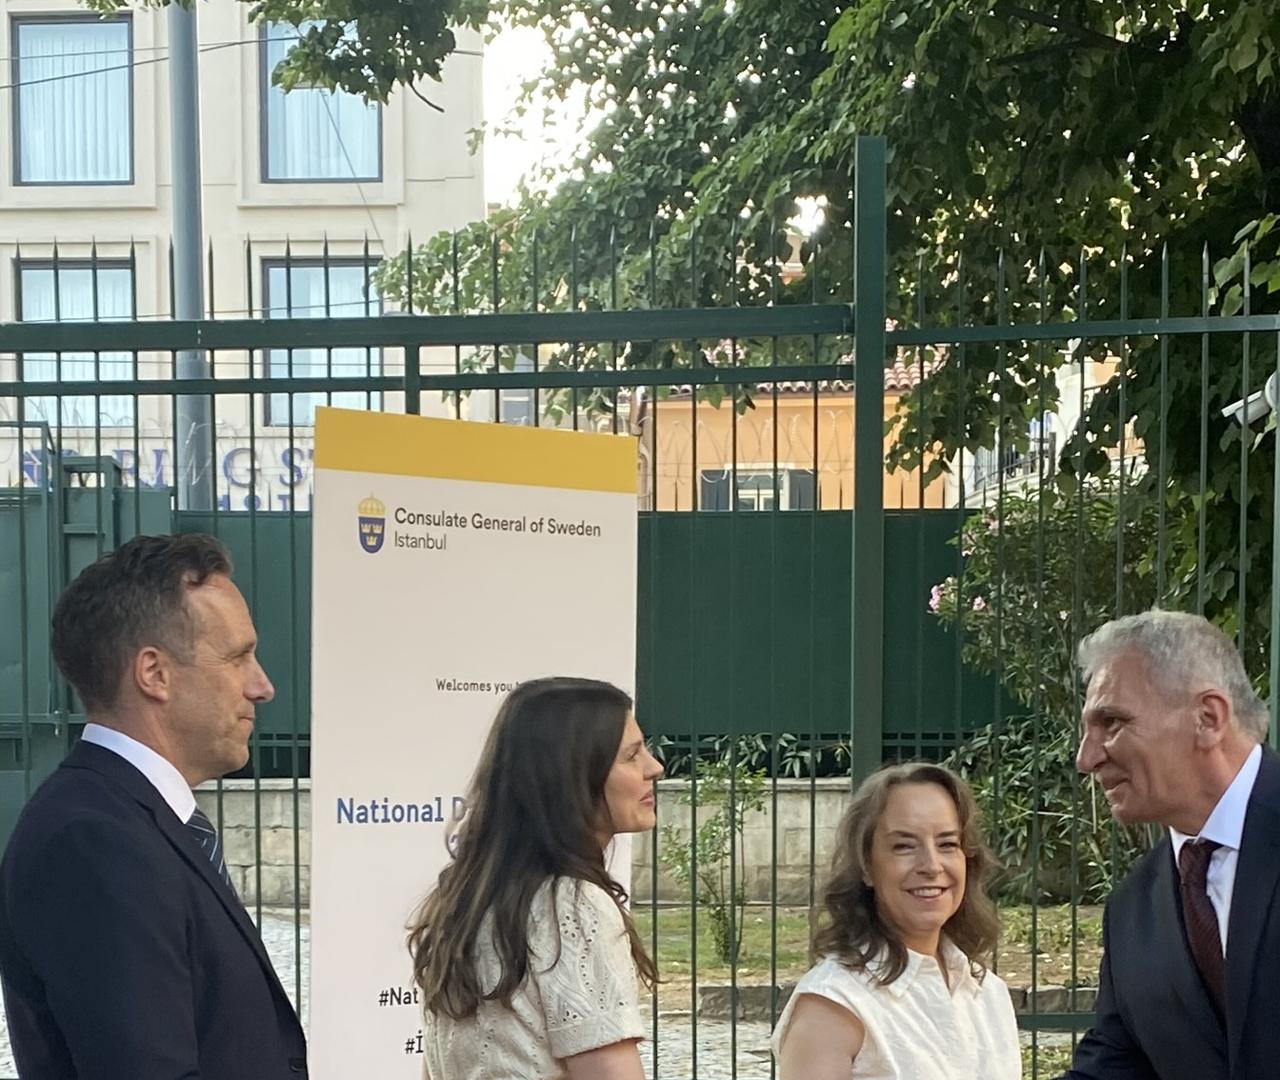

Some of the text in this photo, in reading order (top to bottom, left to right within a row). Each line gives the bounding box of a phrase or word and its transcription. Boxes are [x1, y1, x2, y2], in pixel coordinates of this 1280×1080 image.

[394, 507, 601, 537] Consulate General of Sweden
[394, 530, 447, 551] Istanbul
[435, 678, 492, 692] Welcomes
[494, 682, 513, 696] you
[336, 796, 445, 824] National
[378, 987, 419, 1006] #Nat
